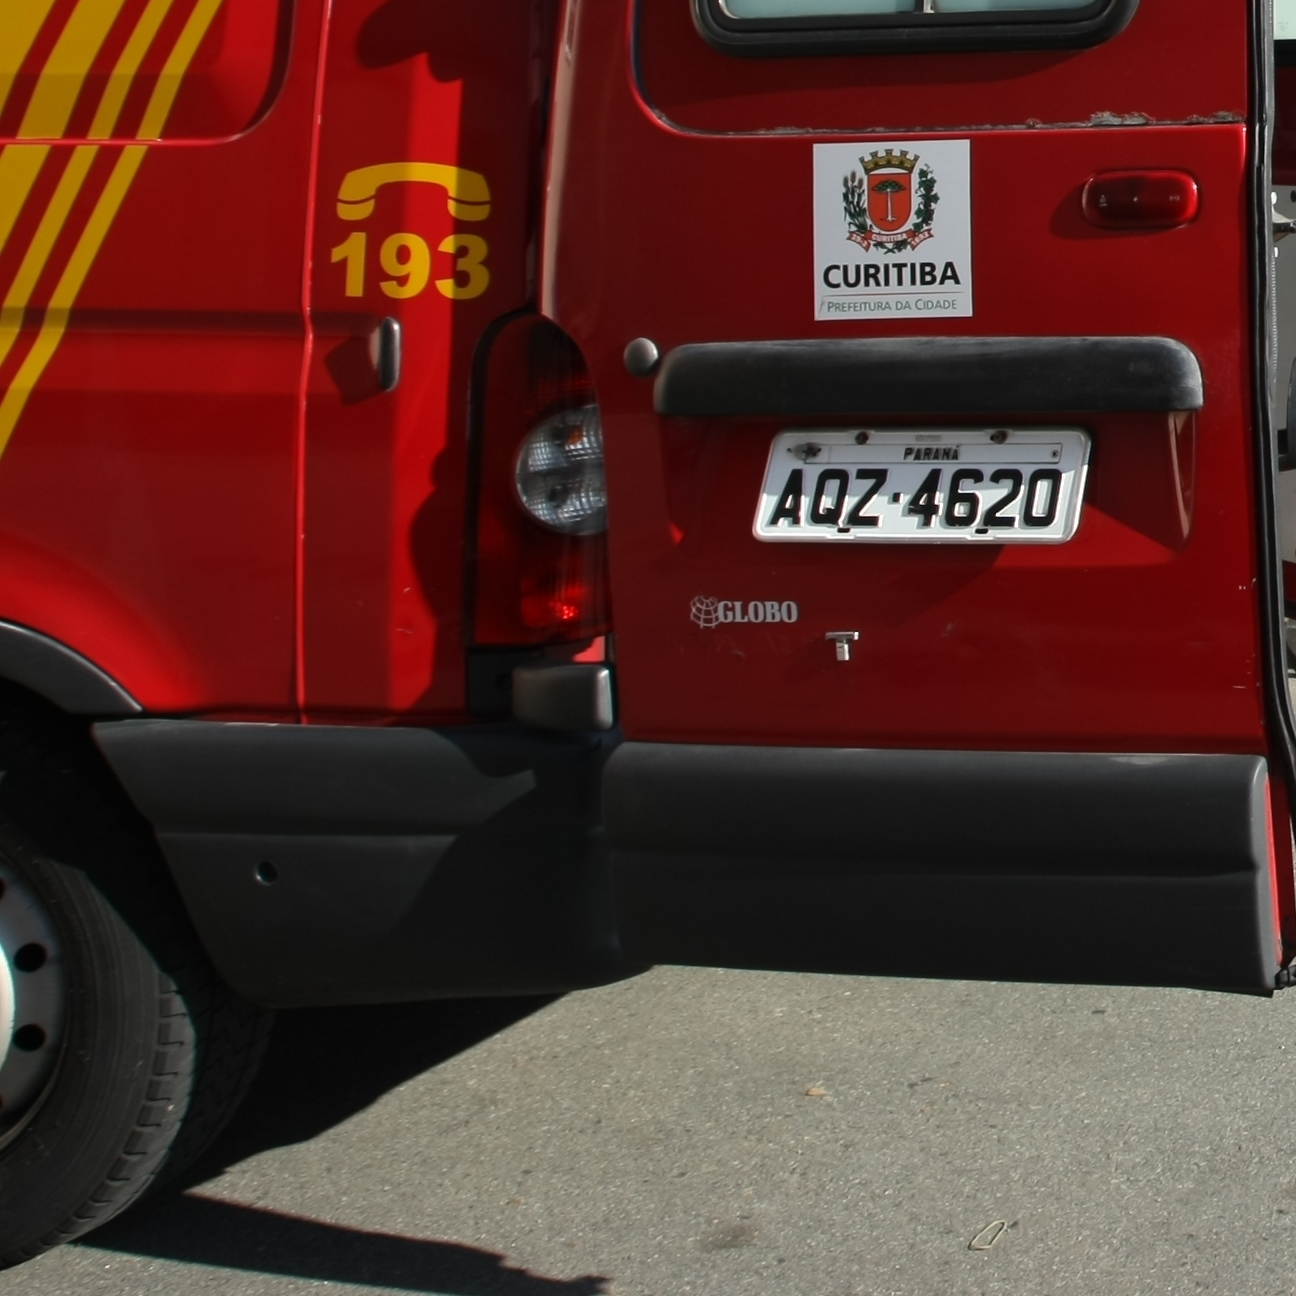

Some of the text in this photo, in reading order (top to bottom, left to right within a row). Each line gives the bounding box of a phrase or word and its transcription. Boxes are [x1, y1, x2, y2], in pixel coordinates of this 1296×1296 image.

[330, 231, 490, 299] 193
[823, 261, 961, 288] CURITIBA
[827, 298, 957, 312] PREFEITURA DA CIDADE
[717, 600, 798, 623] GLOBO
